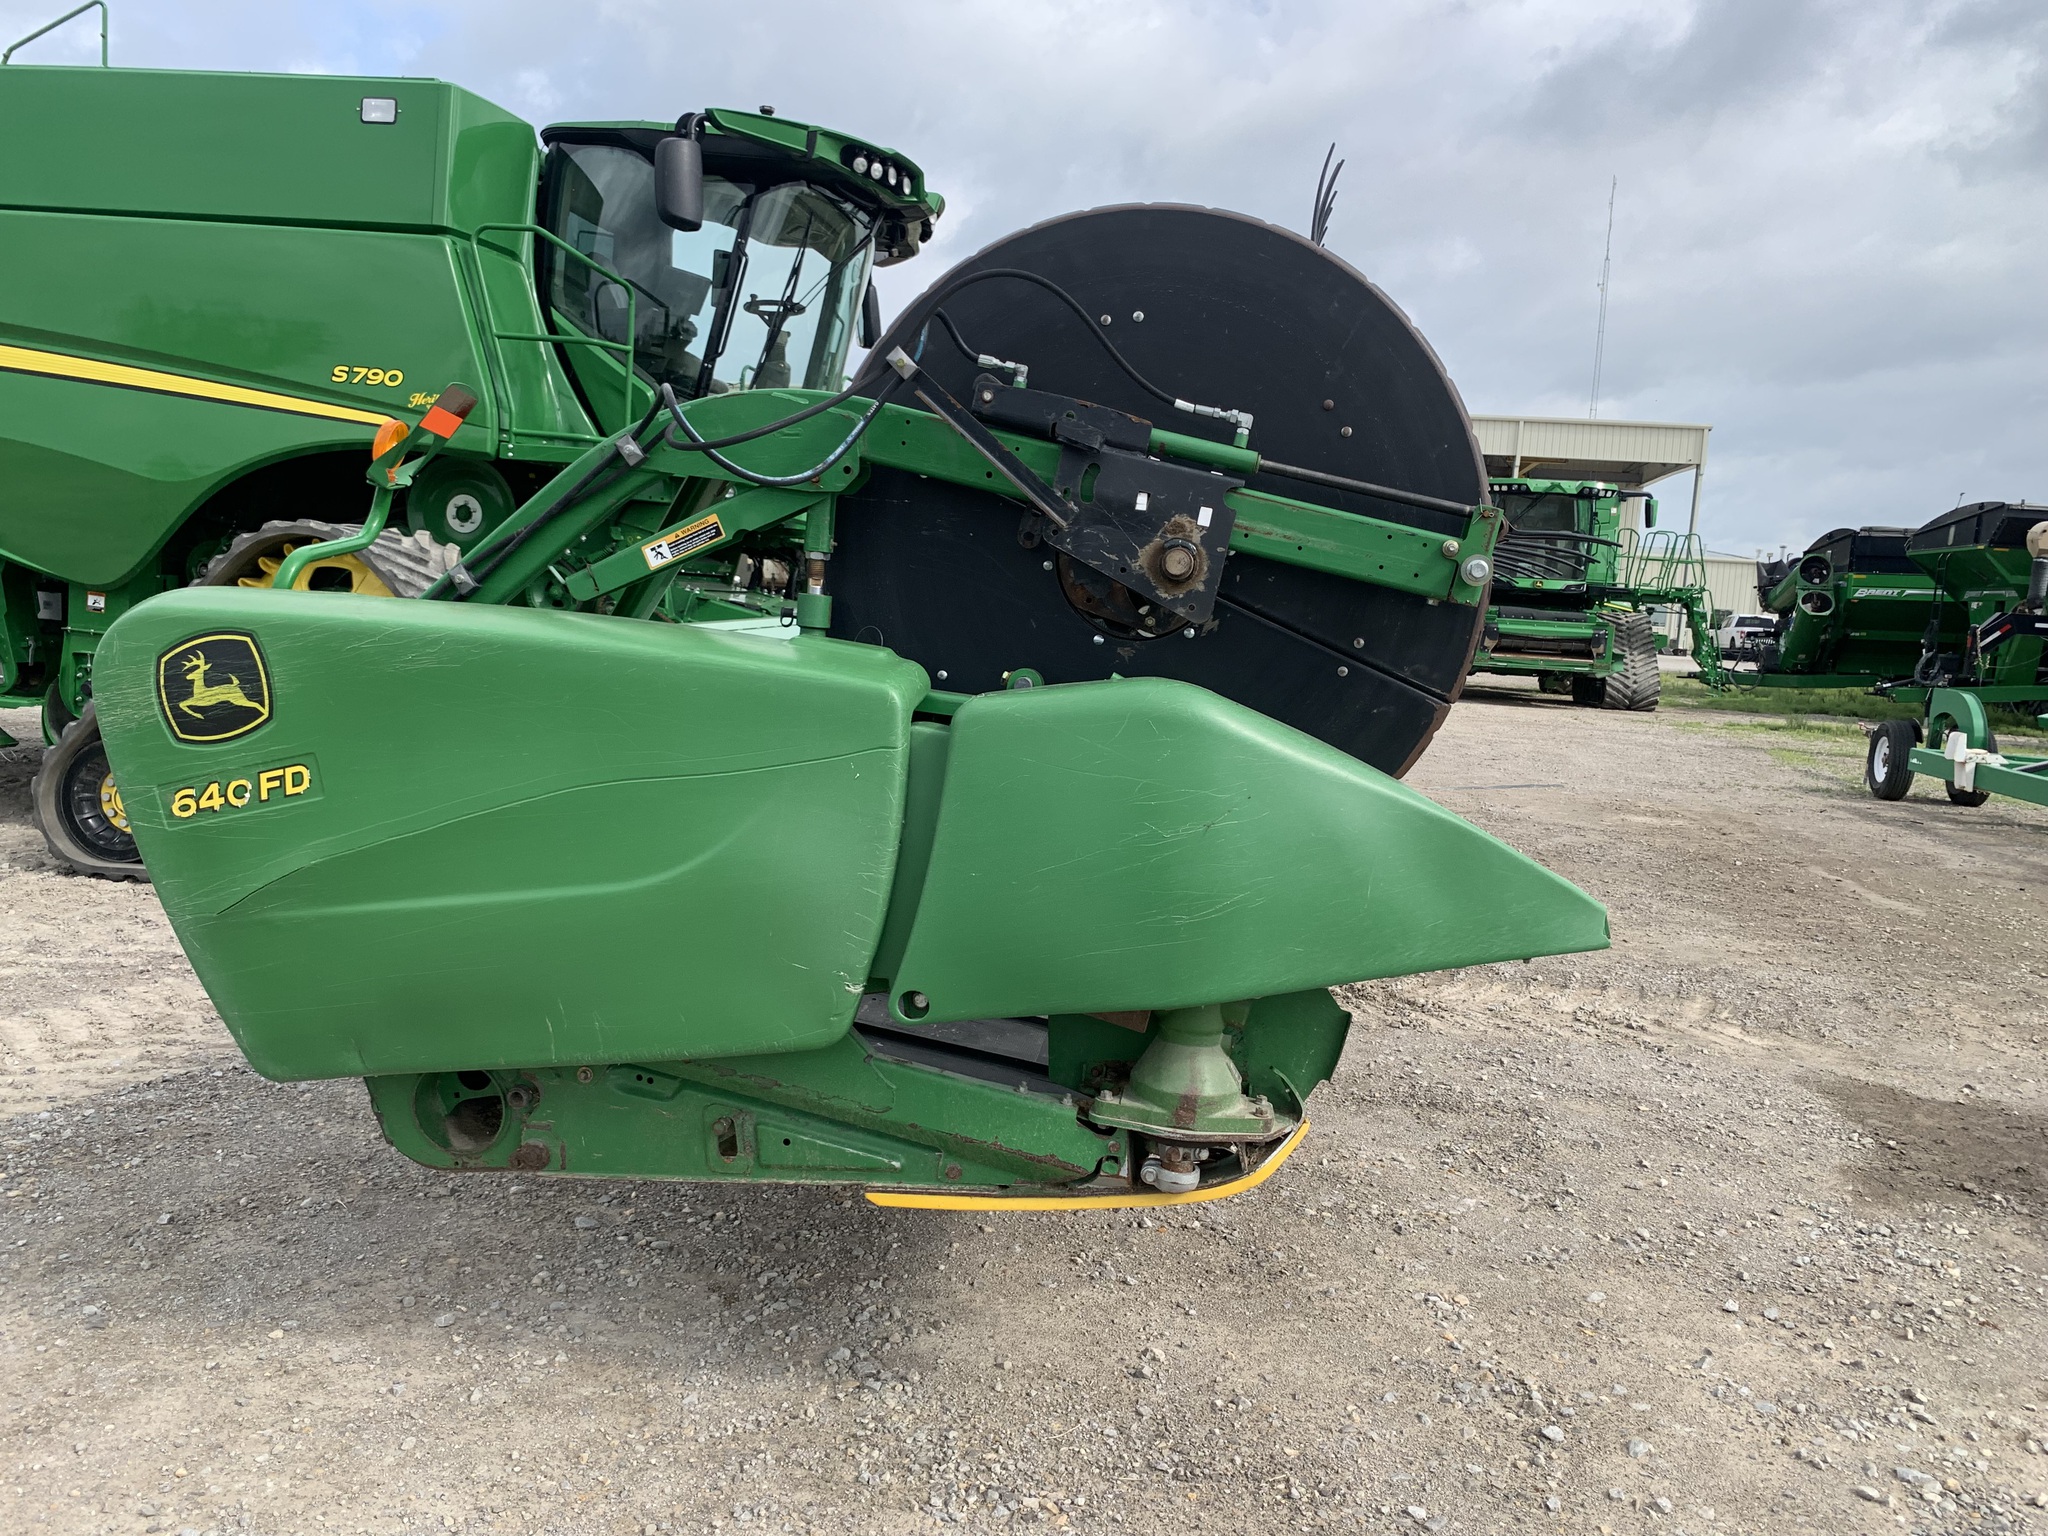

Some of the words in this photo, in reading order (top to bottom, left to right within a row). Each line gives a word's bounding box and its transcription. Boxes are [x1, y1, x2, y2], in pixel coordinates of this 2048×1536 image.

[680, 518, 710, 536] WARNING
[171, 779, 252, 818] 640
[258, 764, 311, 802] FD
